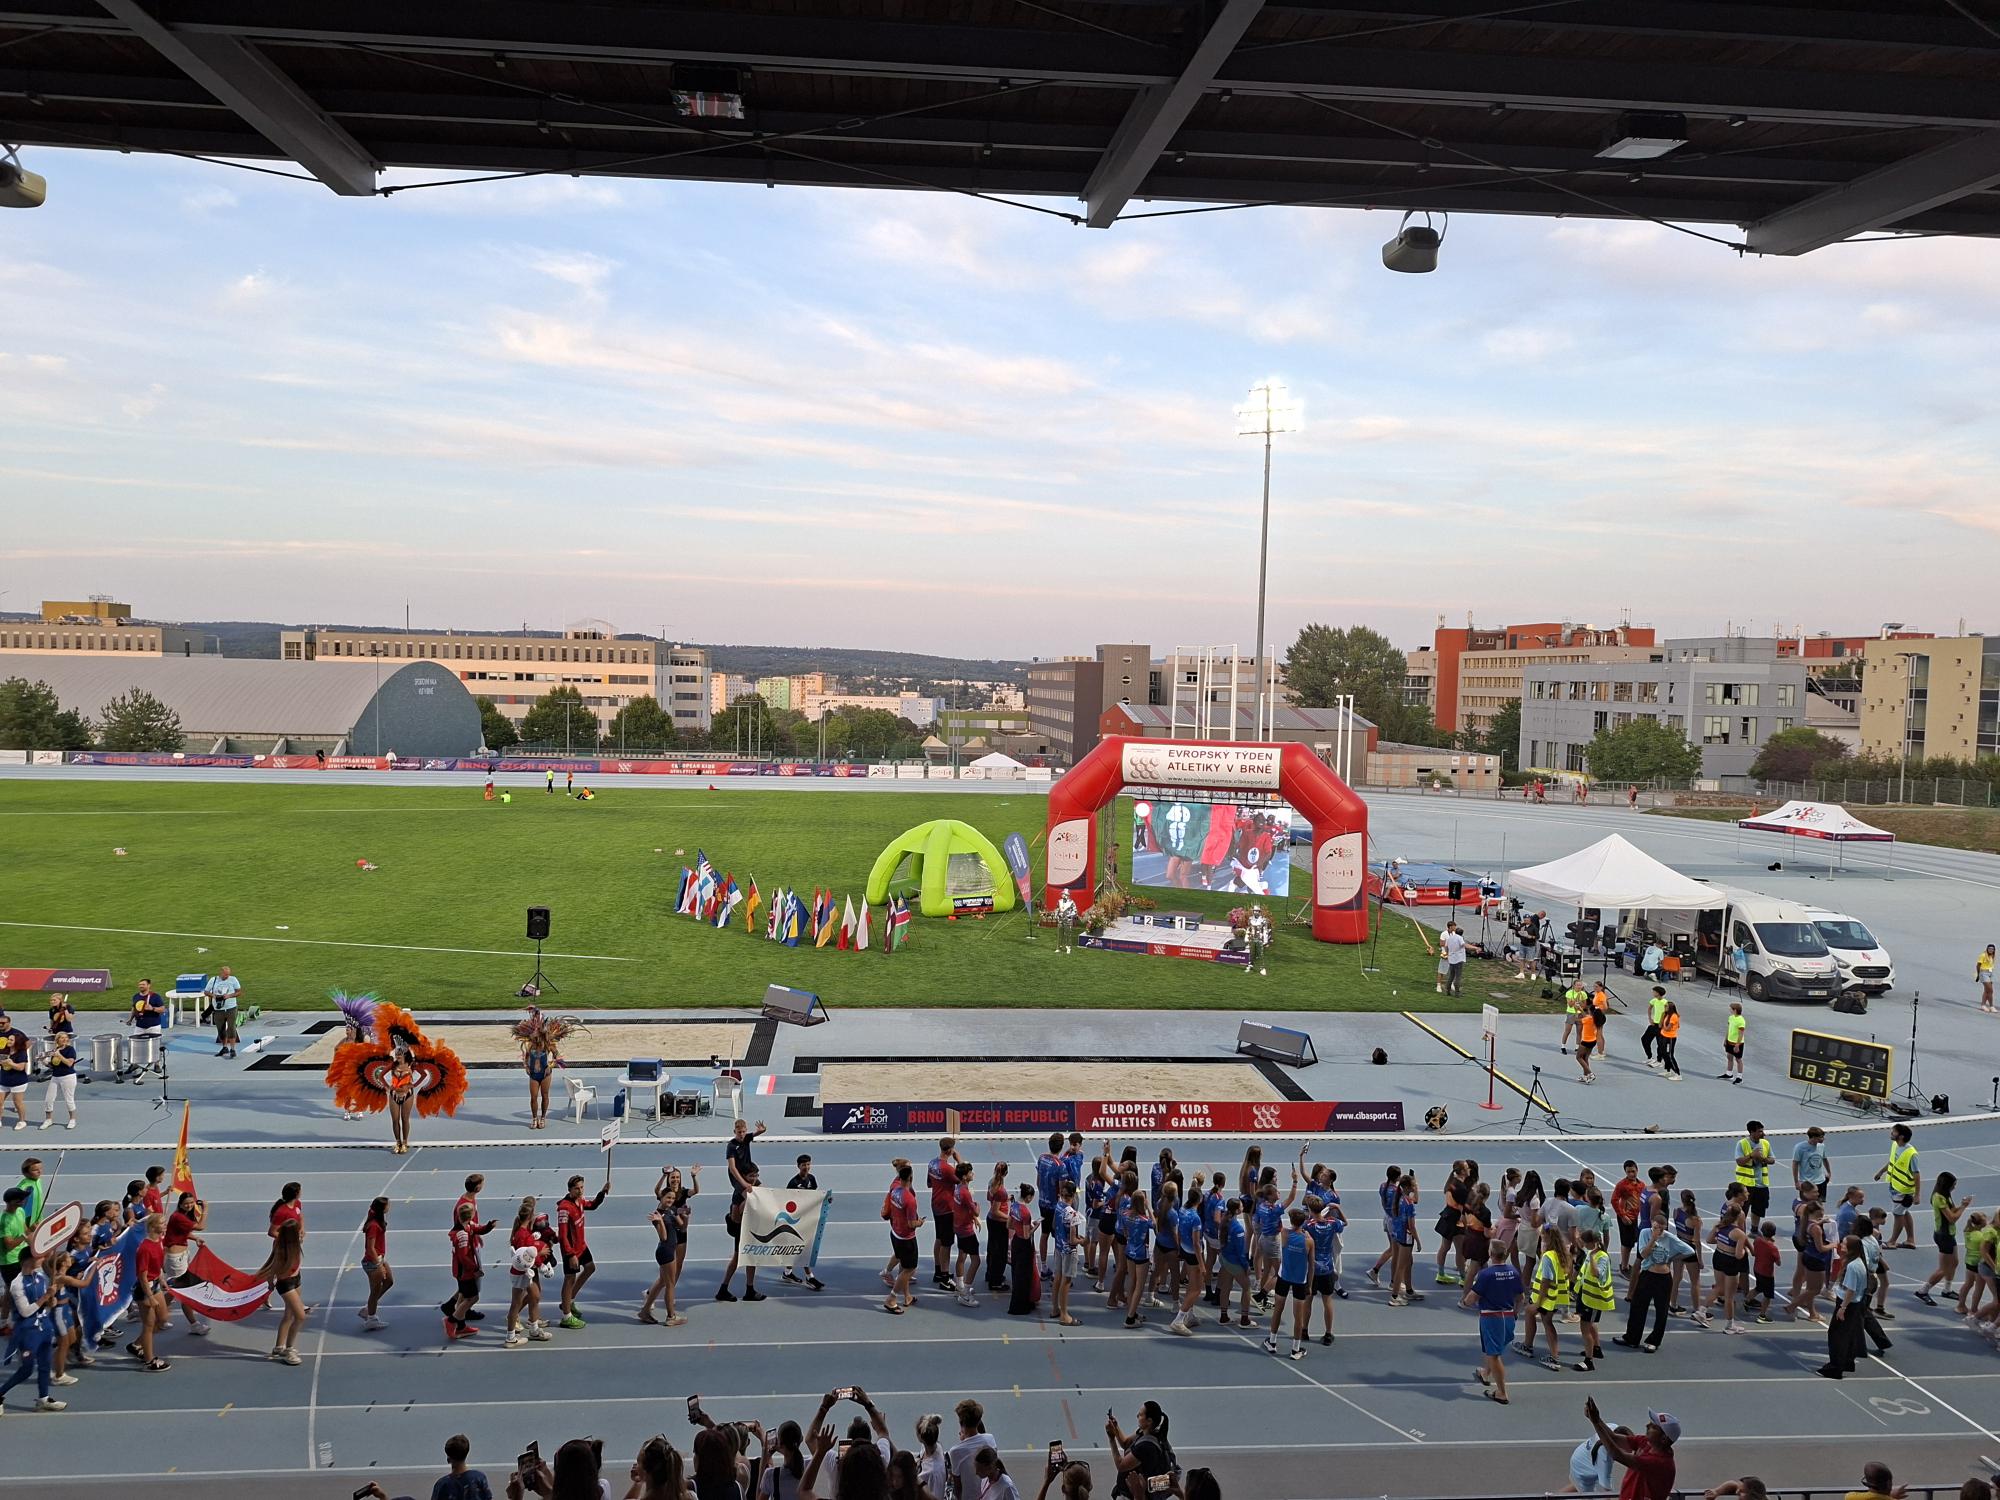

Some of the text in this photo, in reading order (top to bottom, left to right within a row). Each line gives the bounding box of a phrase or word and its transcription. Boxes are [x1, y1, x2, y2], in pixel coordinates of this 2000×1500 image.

[1168, 749, 1230, 759] EVROPSKÝ
[1235, 750, 1273, 761] TÝDEN
[1167, 761, 1221, 772] ATLETIKY
[1226, 763, 1234, 773] V
[1145, 916, 1152, 926] 2
[1177, 917, 1183, 928] 1
[52, 976, 102, 985] www.cibasport.cz
[1101, 1104, 1210, 1115] EUROPEAN KIDS
[908, 1110, 1068, 1123] BRNO CZECH REPUBLIC
[1335, 1111, 1398, 1122] www.cibasport.cz
[1091, 1117, 1213, 1128] ATHLETICS GAMES
[742, 1244, 806, 1256] SPORTGUIDES
[1868, 1396, 1932, 1416] 8
